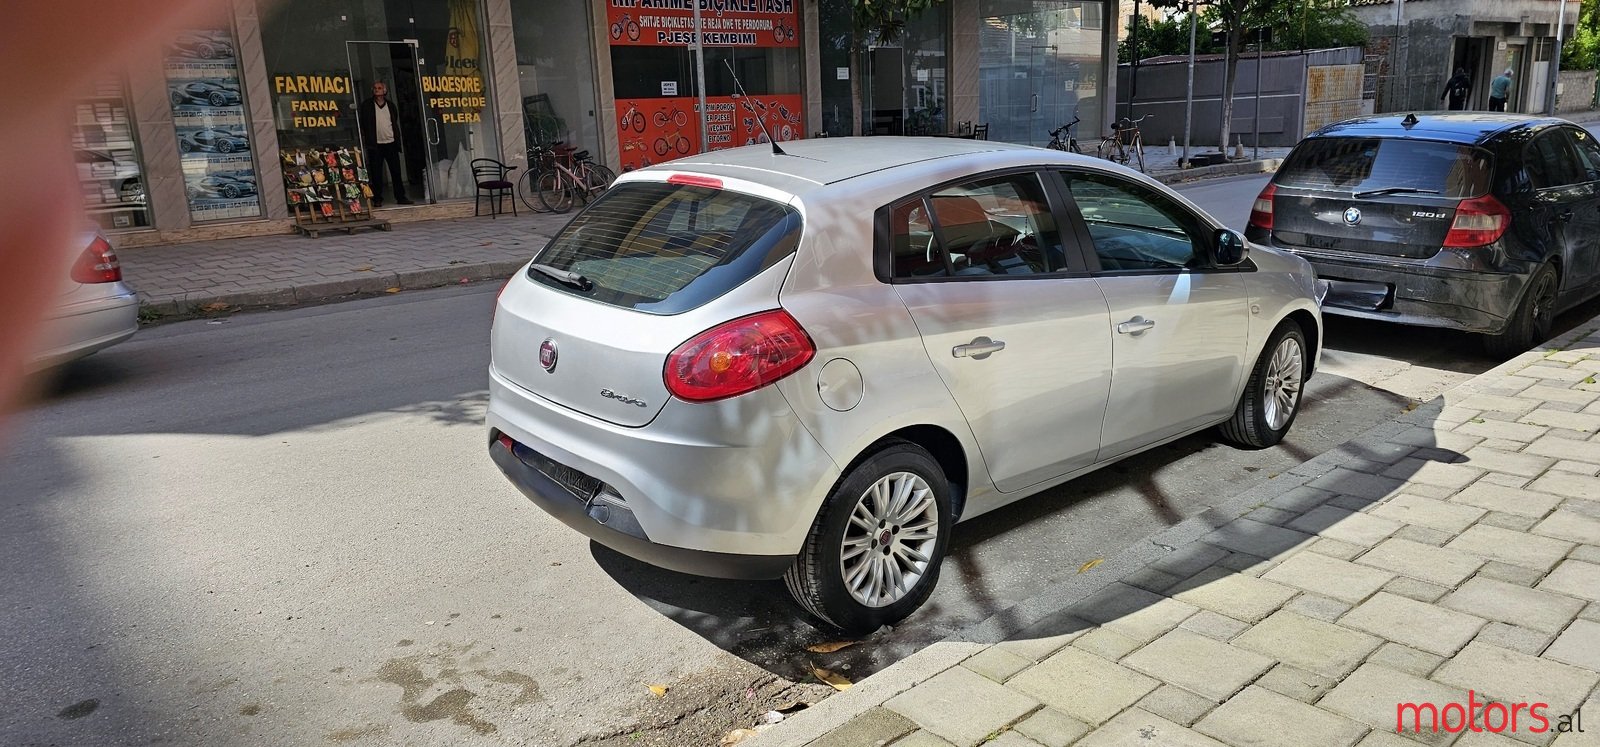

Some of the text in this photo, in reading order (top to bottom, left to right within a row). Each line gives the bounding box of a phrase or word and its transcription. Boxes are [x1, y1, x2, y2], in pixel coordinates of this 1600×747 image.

[640, 16, 661, 28] SHITJE
[735, 19, 742, 30] TE
[702, 32, 757, 45] KEMBIMI
[275, 75, 351, 94] FARMACI
[421, 76, 481, 93] BUJQESORE
[291, 100, 339, 112] FARNA
[430, 97, 486, 109] PESTICIDE
[293, 116, 337, 128] FIDAN
[442, 112, 481, 124] PLERA
[1412, 211, 1446, 219] 120d
